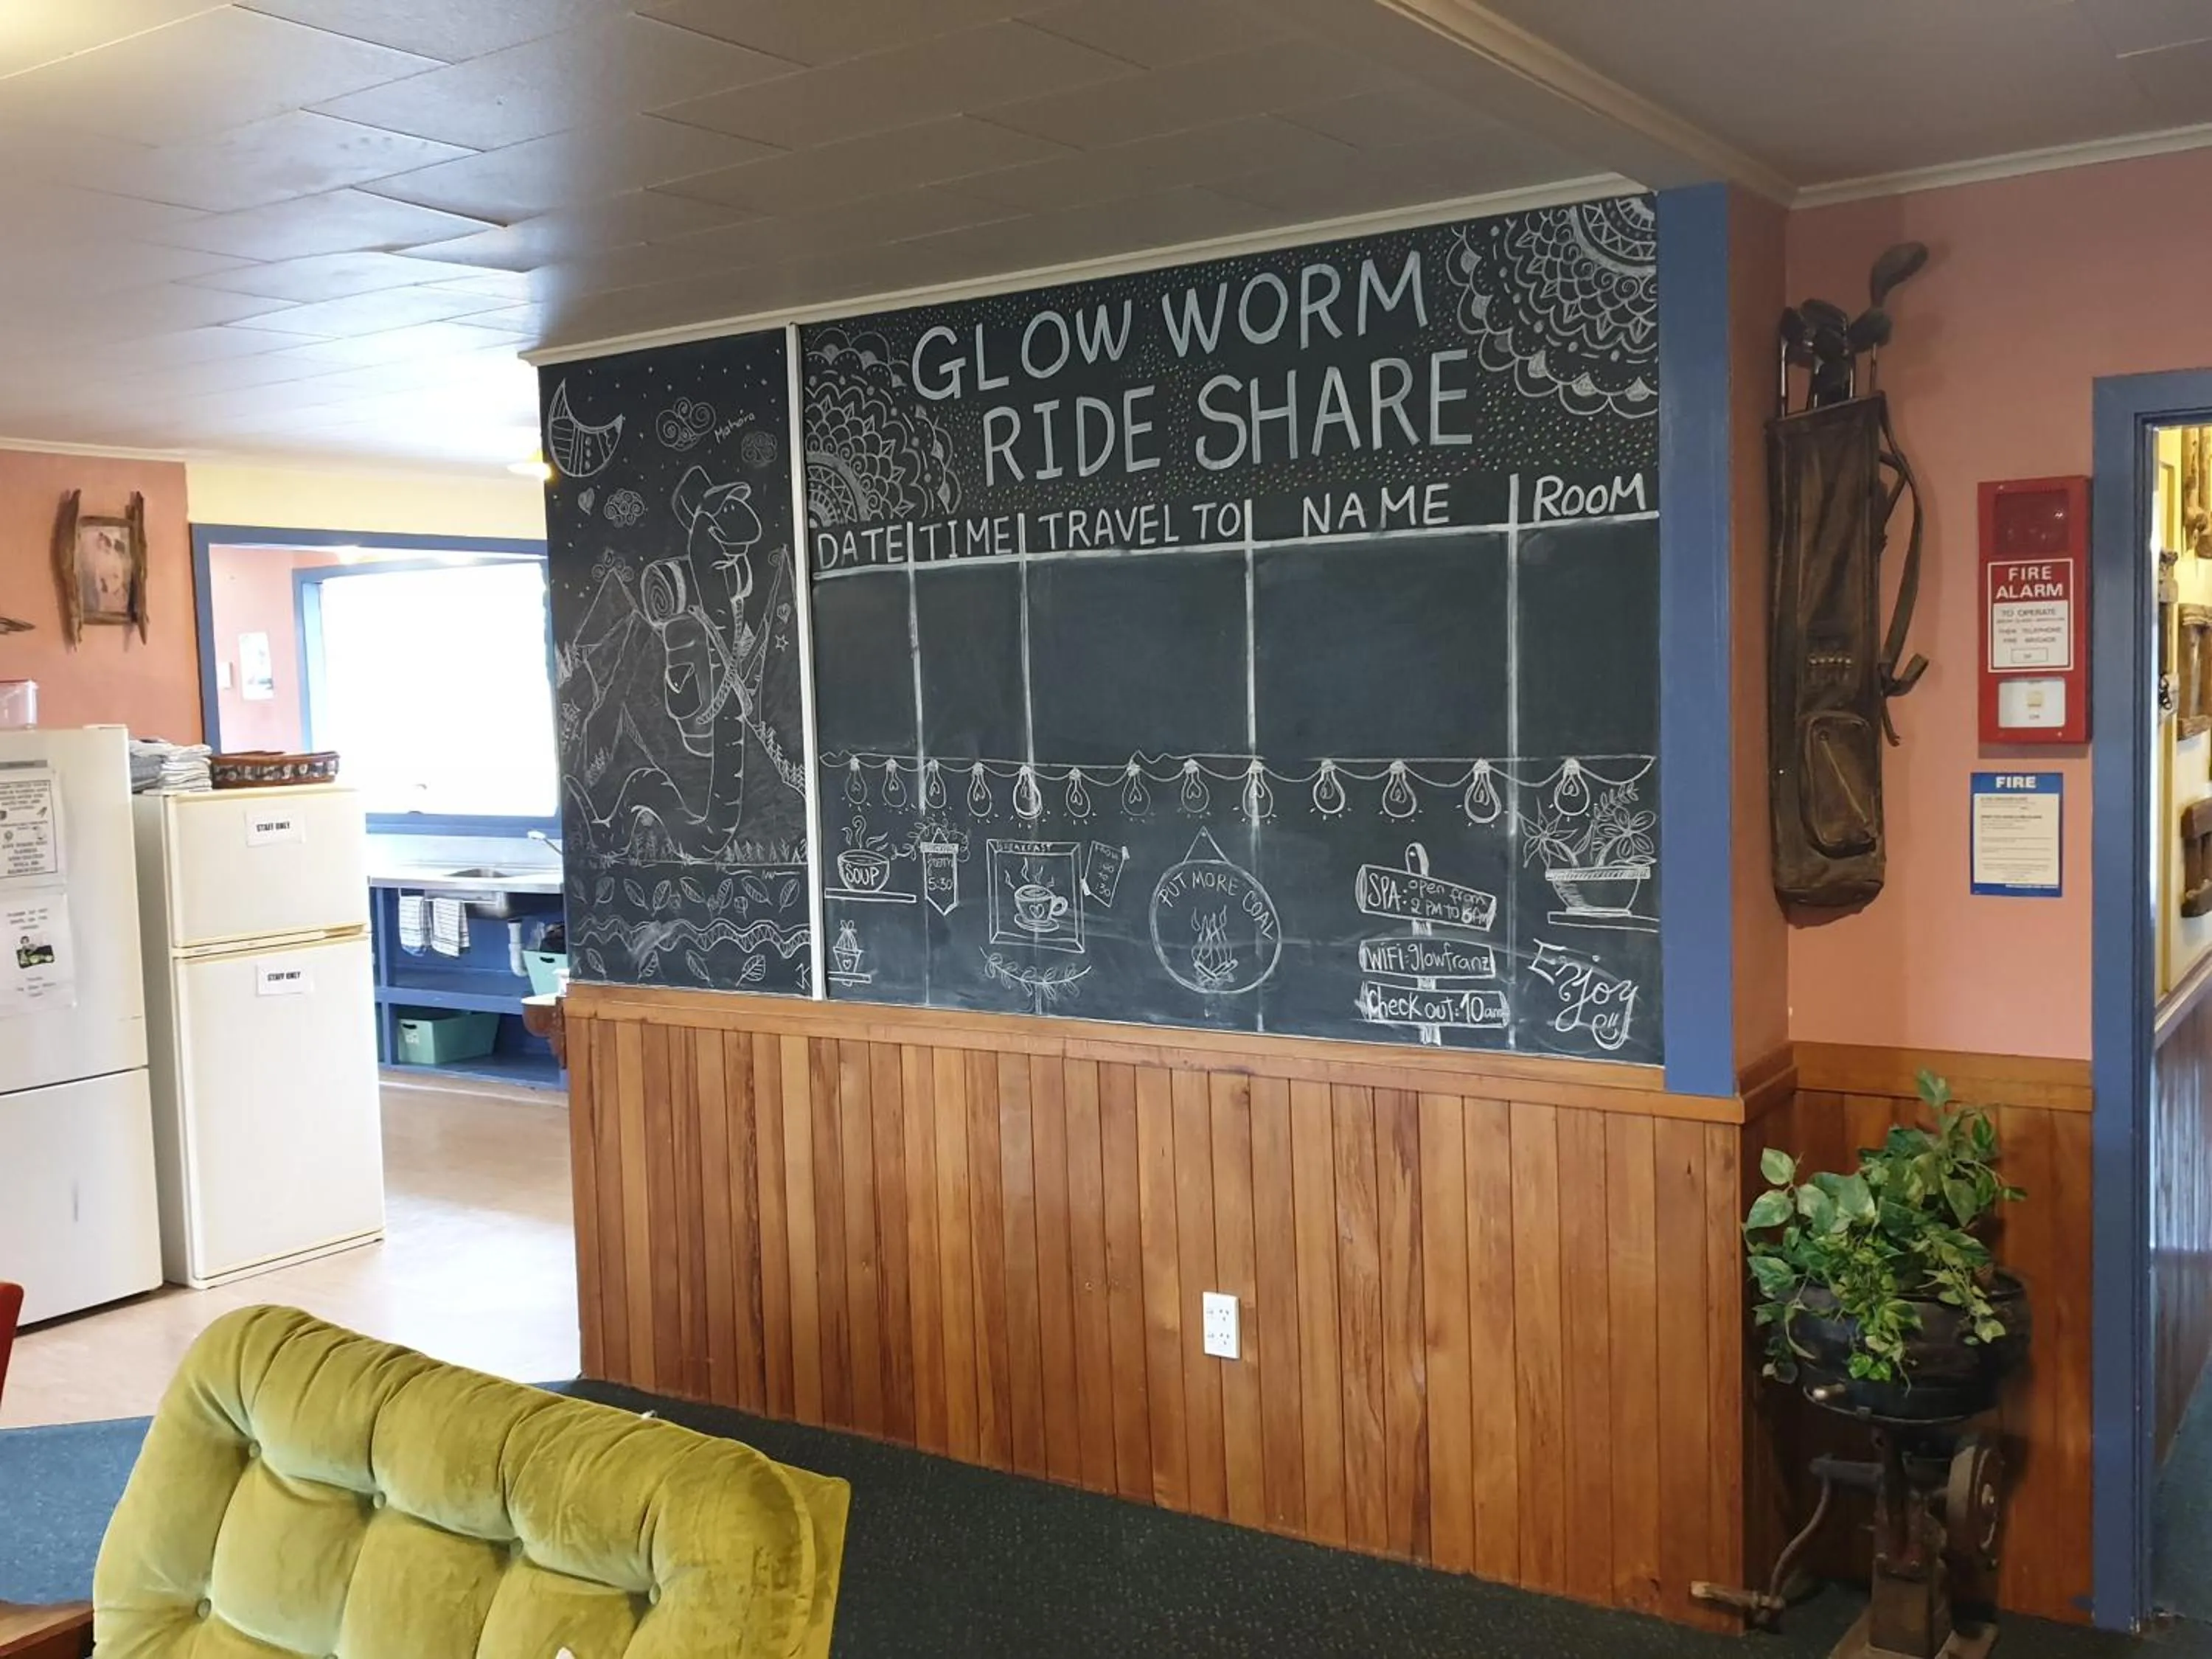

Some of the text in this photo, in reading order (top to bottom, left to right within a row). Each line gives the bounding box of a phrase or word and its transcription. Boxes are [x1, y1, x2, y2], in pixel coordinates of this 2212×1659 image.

[911, 250, 1429, 401] GLOW WORM
[982, 348, 1473, 487] RIDE SHARE
[818, 473, 1646, 570] DATE TIME TRAVEL TO NAME ROOM
[1995, 583, 2064, 599] ALARM
[2008, 566, 2052, 581] FIRE
[1995, 776, 2037, 789] FIRE
[845, 863, 880, 886] SOUP
[1158, 870, 1275, 941] PUT MORE COAL
